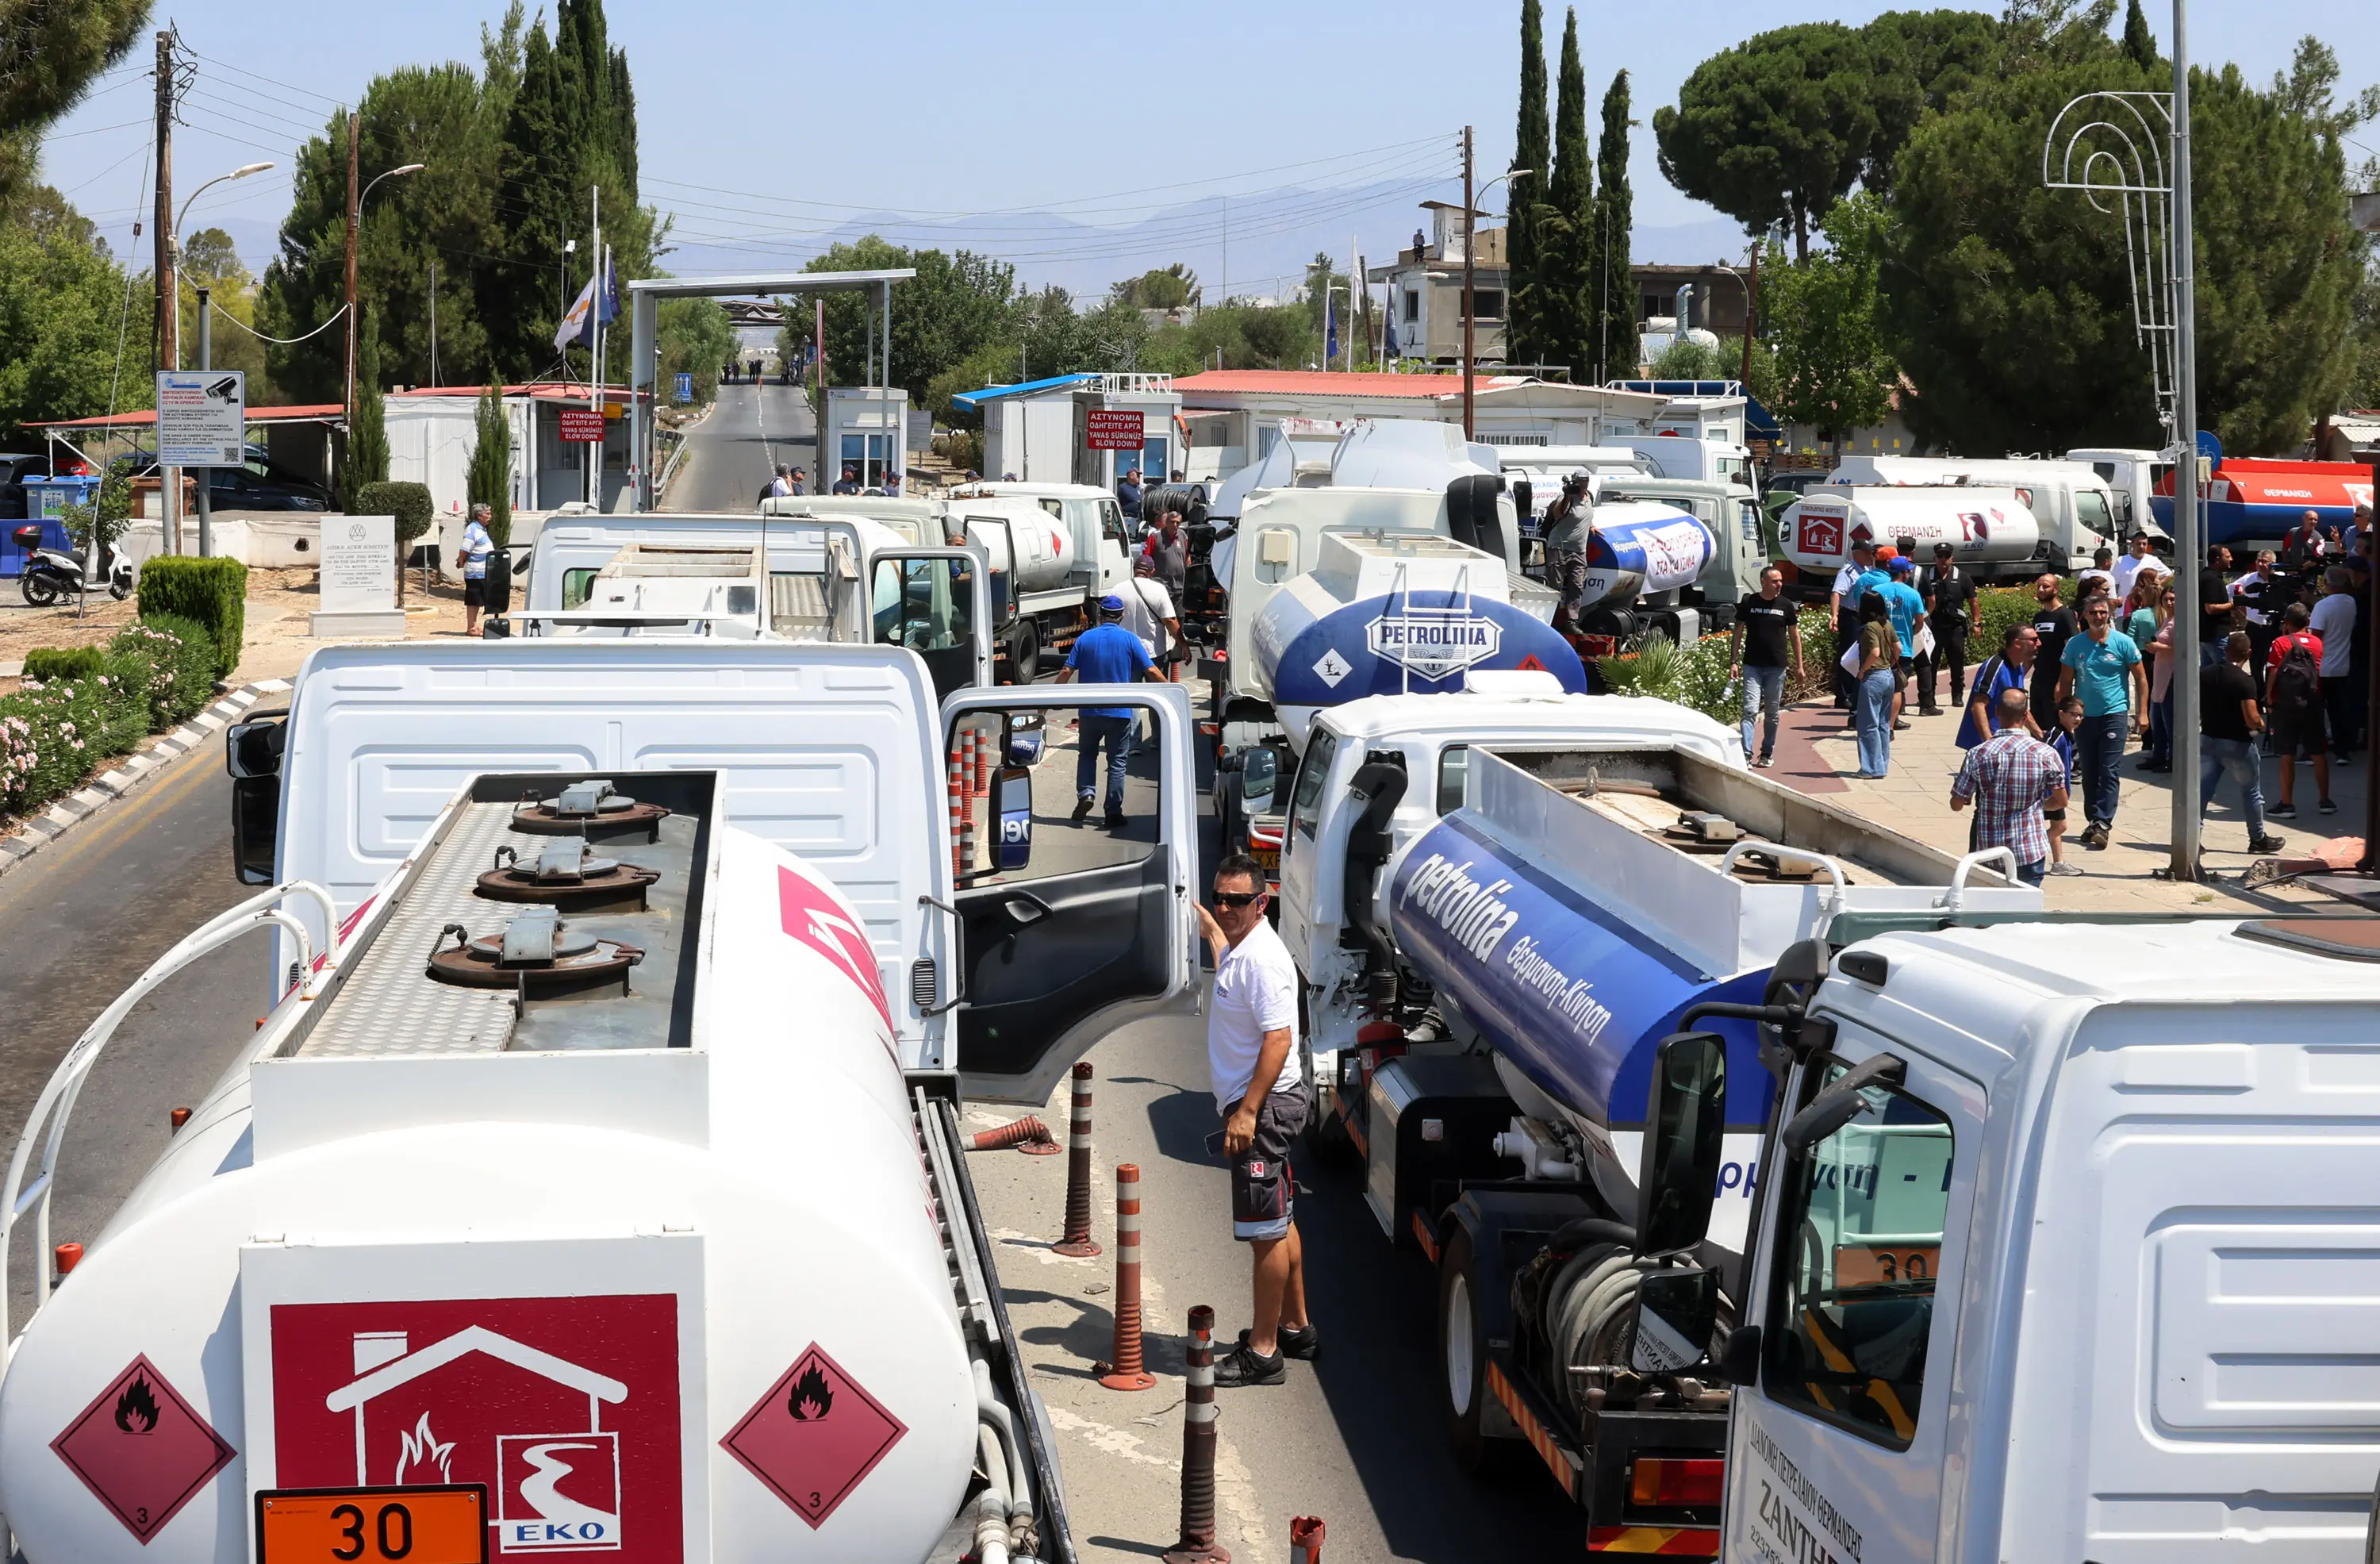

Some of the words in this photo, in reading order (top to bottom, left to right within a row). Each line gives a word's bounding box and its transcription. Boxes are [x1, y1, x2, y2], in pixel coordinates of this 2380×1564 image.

[2263, 488, 2313, 498] ΘΕΡΜΑΝΣΗ
[1888, 526, 1942, 538] ΘΕΡΜΑΝΣΗ
[1381, 626, 1488, 645] PETROLINA
[1399, 853, 1518, 963] petrolina
[1877, 1252, 1928, 1282] 30
[809, 1491, 821, 1508] 3
[1750, 1420, 1779, 1474] ΔΙΑΝΟΜΗ
[1778, 1451, 1818, 1516] ΠΕΤΡΕΛΑΙΟΥ
[1818, 1494, 1863, 1564] ΘΕΡΜΑΝΣΗΣ
[136, 1507, 149, 1524] 3
[330, 1502, 413, 1561] 30
[516, 1522, 605, 1542] EKO
